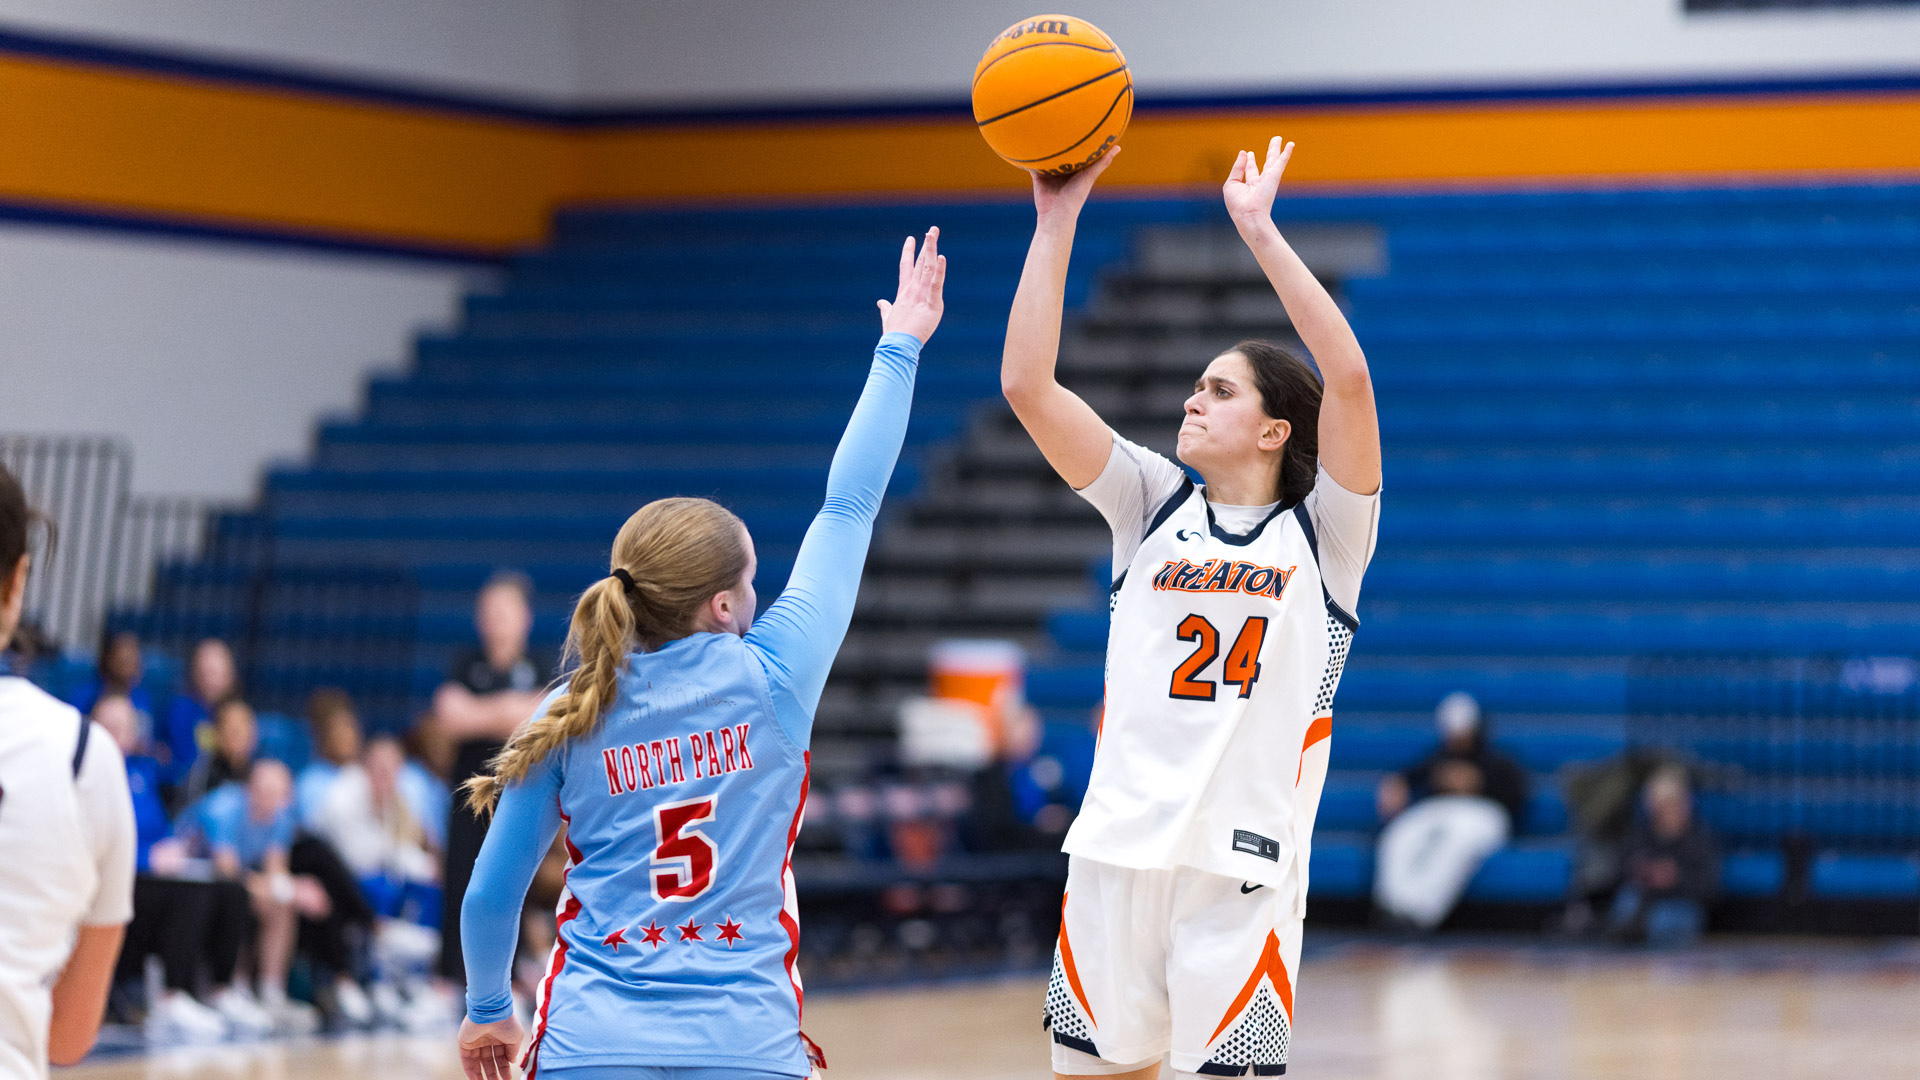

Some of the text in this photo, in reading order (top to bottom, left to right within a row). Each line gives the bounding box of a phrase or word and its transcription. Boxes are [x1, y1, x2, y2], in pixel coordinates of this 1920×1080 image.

[1152, 558, 1297, 600] WHEATON
[1169, 613, 1269, 702] 24
[602, 723, 754, 796] NORTH PARK
[650, 793, 719, 903] 5
[1266, 844, 1272, 853] L
